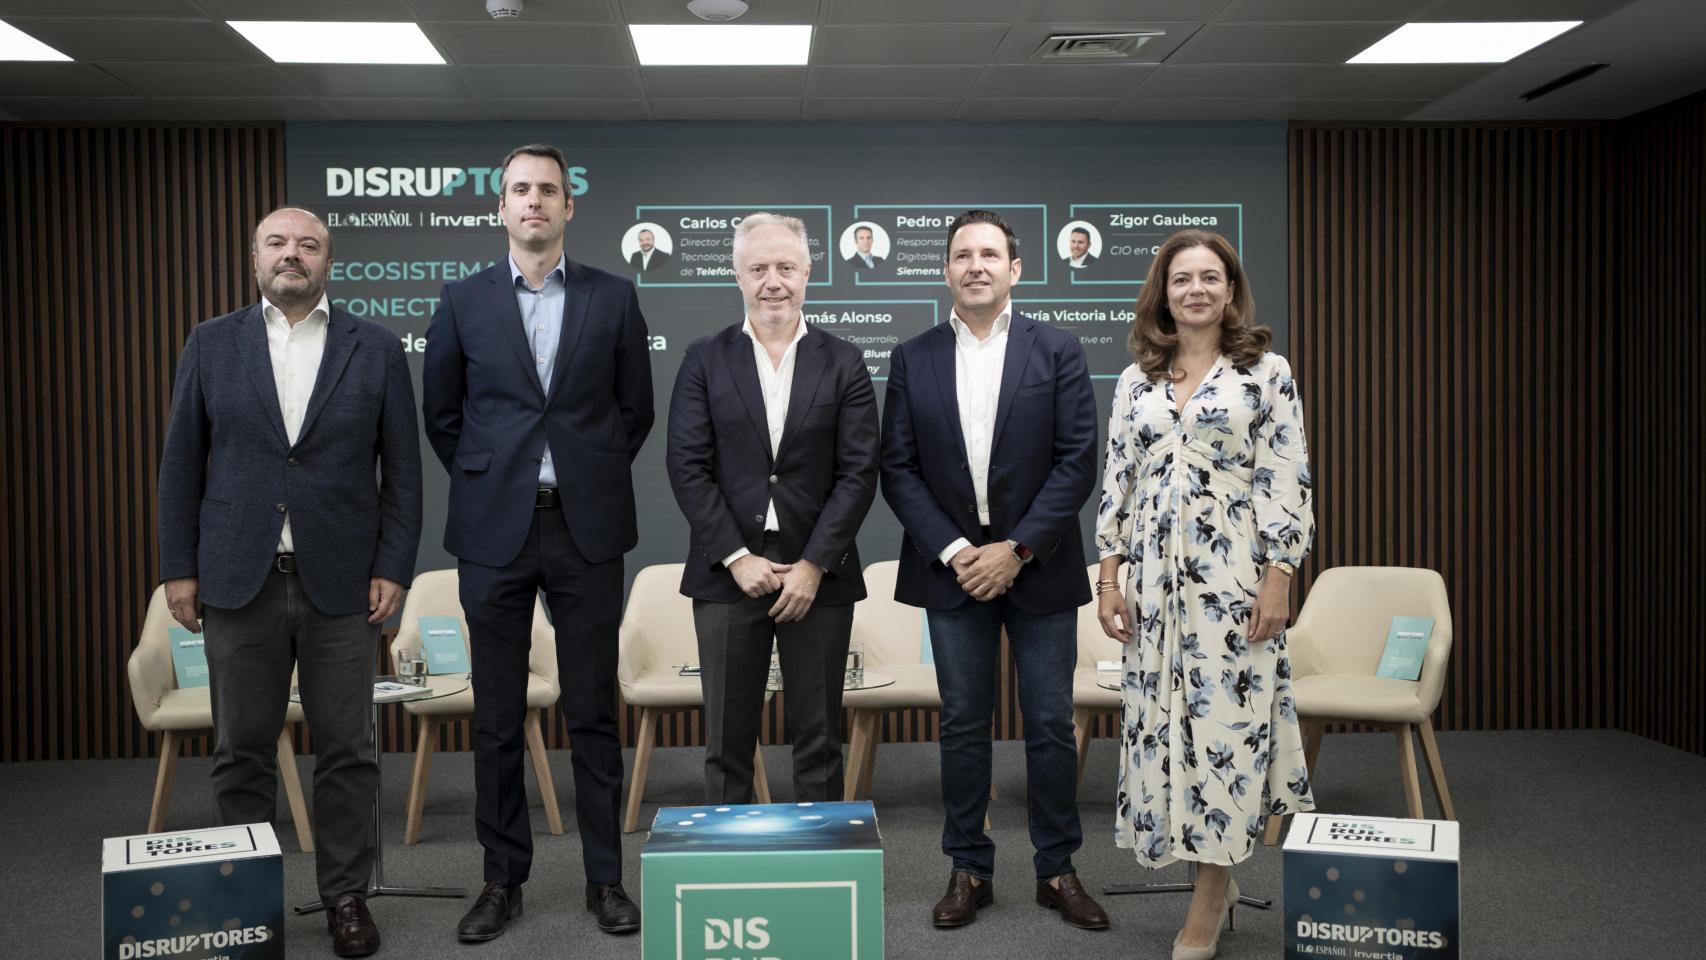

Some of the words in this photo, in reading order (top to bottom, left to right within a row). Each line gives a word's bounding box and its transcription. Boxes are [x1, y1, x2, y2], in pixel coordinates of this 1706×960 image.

[326, 166, 589, 197] DISRUPTS
[361, 210, 412, 227] ESPAÑOL
[430, 212, 506, 227] inverti
[680, 217, 727, 229] Carlos
[896, 215, 941, 227] Pedro
[1109, 213, 1149, 228] Zigor
[1152, 214, 1218, 226] Gaubeca
[680, 238, 720, 247] Director
[1110, 245, 1131, 255] CIO
[1133, 247, 1148, 255] en
[896, 252, 941, 263] Digitales
[680, 267, 694, 276] de
[896, 266, 941, 276] Siemens
[805, 311, 837, 323] más
[840, 311, 893, 323] Alonso
[1020, 309, 1050, 321] aría
[1053, 309, 1107, 321] Victoria
[1110, 309, 1136, 323] Lóp
[847, 335, 898, 344] Desarrollo
[1100, 336, 1113, 344] en
[863, 349, 892, 358] Bluet
[1328, 833, 1416, 845] TORES
[146, 842, 237, 857] TORES
[705, 917, 771, 950] DIS
[1297, 920, 1443, 949] DISRUPTORES
[119, 925, 268, 960] DISRUPTORES
[1354, 949, 1403, 960] invertia
